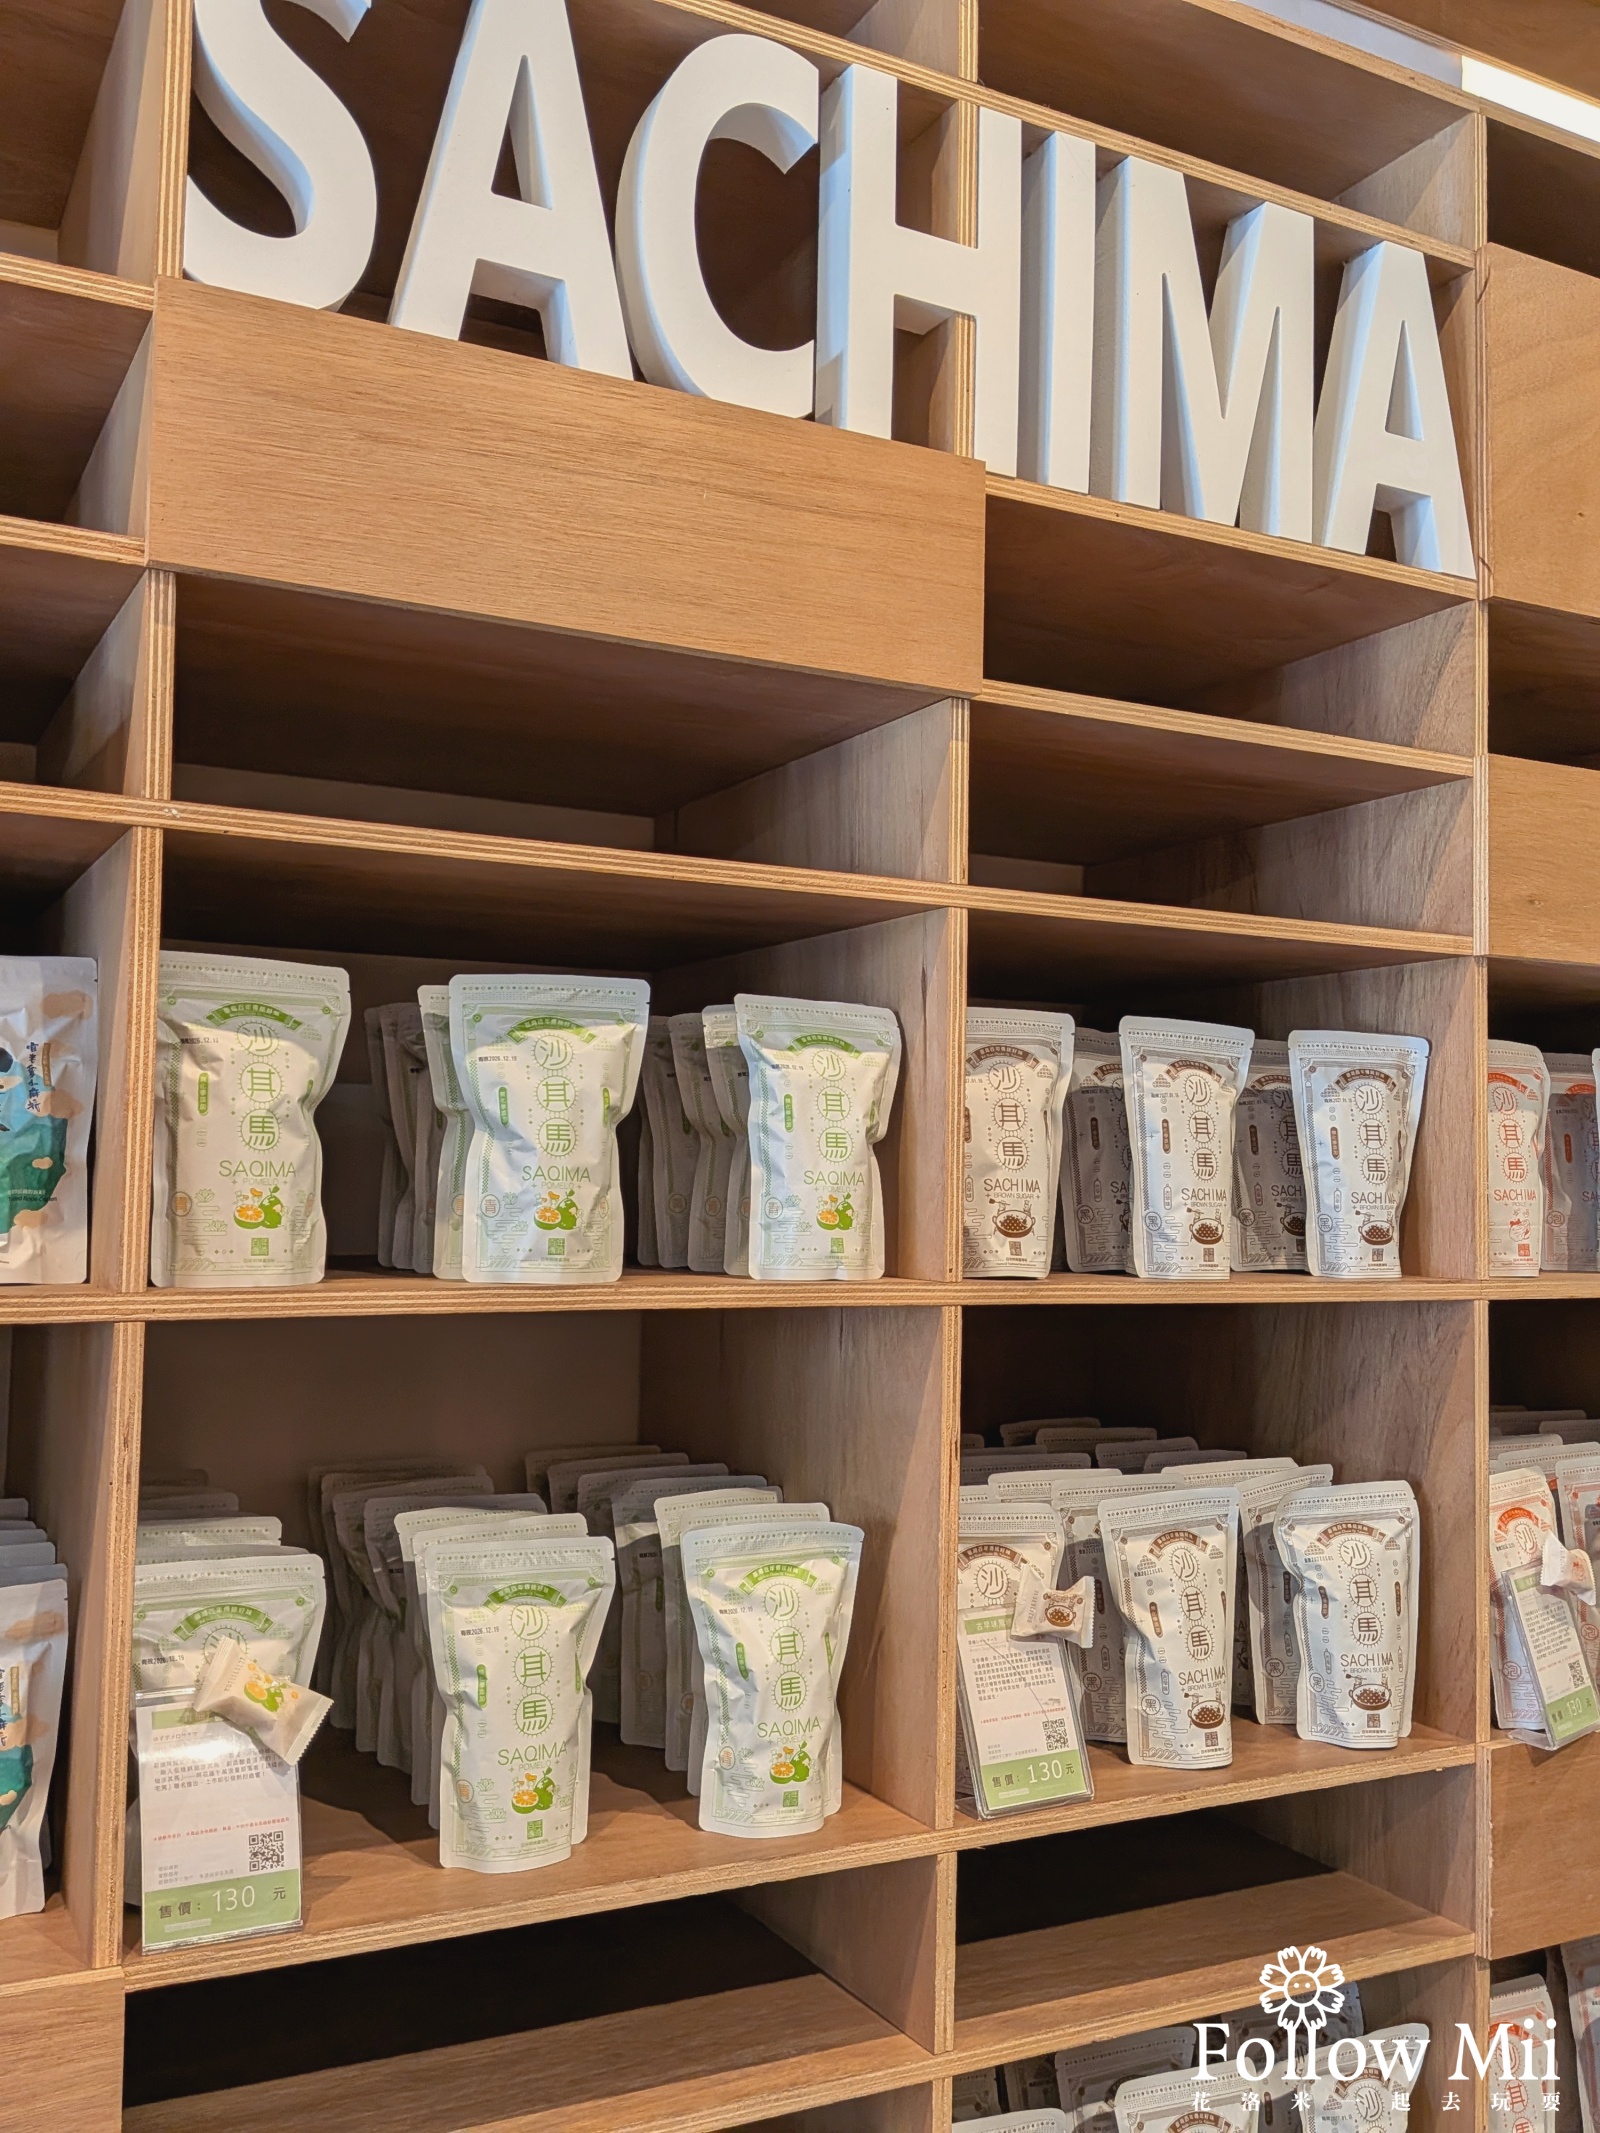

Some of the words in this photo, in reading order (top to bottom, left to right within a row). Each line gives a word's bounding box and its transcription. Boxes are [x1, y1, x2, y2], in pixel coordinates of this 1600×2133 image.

[183, 0, 1476, 580] SACHIMA
[219, 1159, 297, 1178] SAQIMA
[521, 1165, 592, 1182] SAQIMA
[541, 1181, 575, 1190] POMELO
[803, 1170, 866, 1187] SAQIMA
[983, 1178, 1041, 1194] SACHIMA
[1181, 1187, 1228, 1202] SACHIMA
[1350, 1190, 1398, 1205] SACHIMA
[1493, 1188, 1537, 1202] SACHIMA
[1340, 1652, 1394, 1668] SACHIMA
[1178, 1665, 1226, 1686] SACHIMA
[1567, 1697, 1582, 1717] 130
[757, 1720, 822, 1740] SAQIMA
[497, 1744, 568, 1768] SAQIMA
[518, 1760, 552, 1772] POMELO
[1027, 1759, 1062, 1784] 130
[1065, 1763, 1075, 1774] 元
[212, 1885, 256, 1912] 130
[273, 1886, 286, 1901] 元
